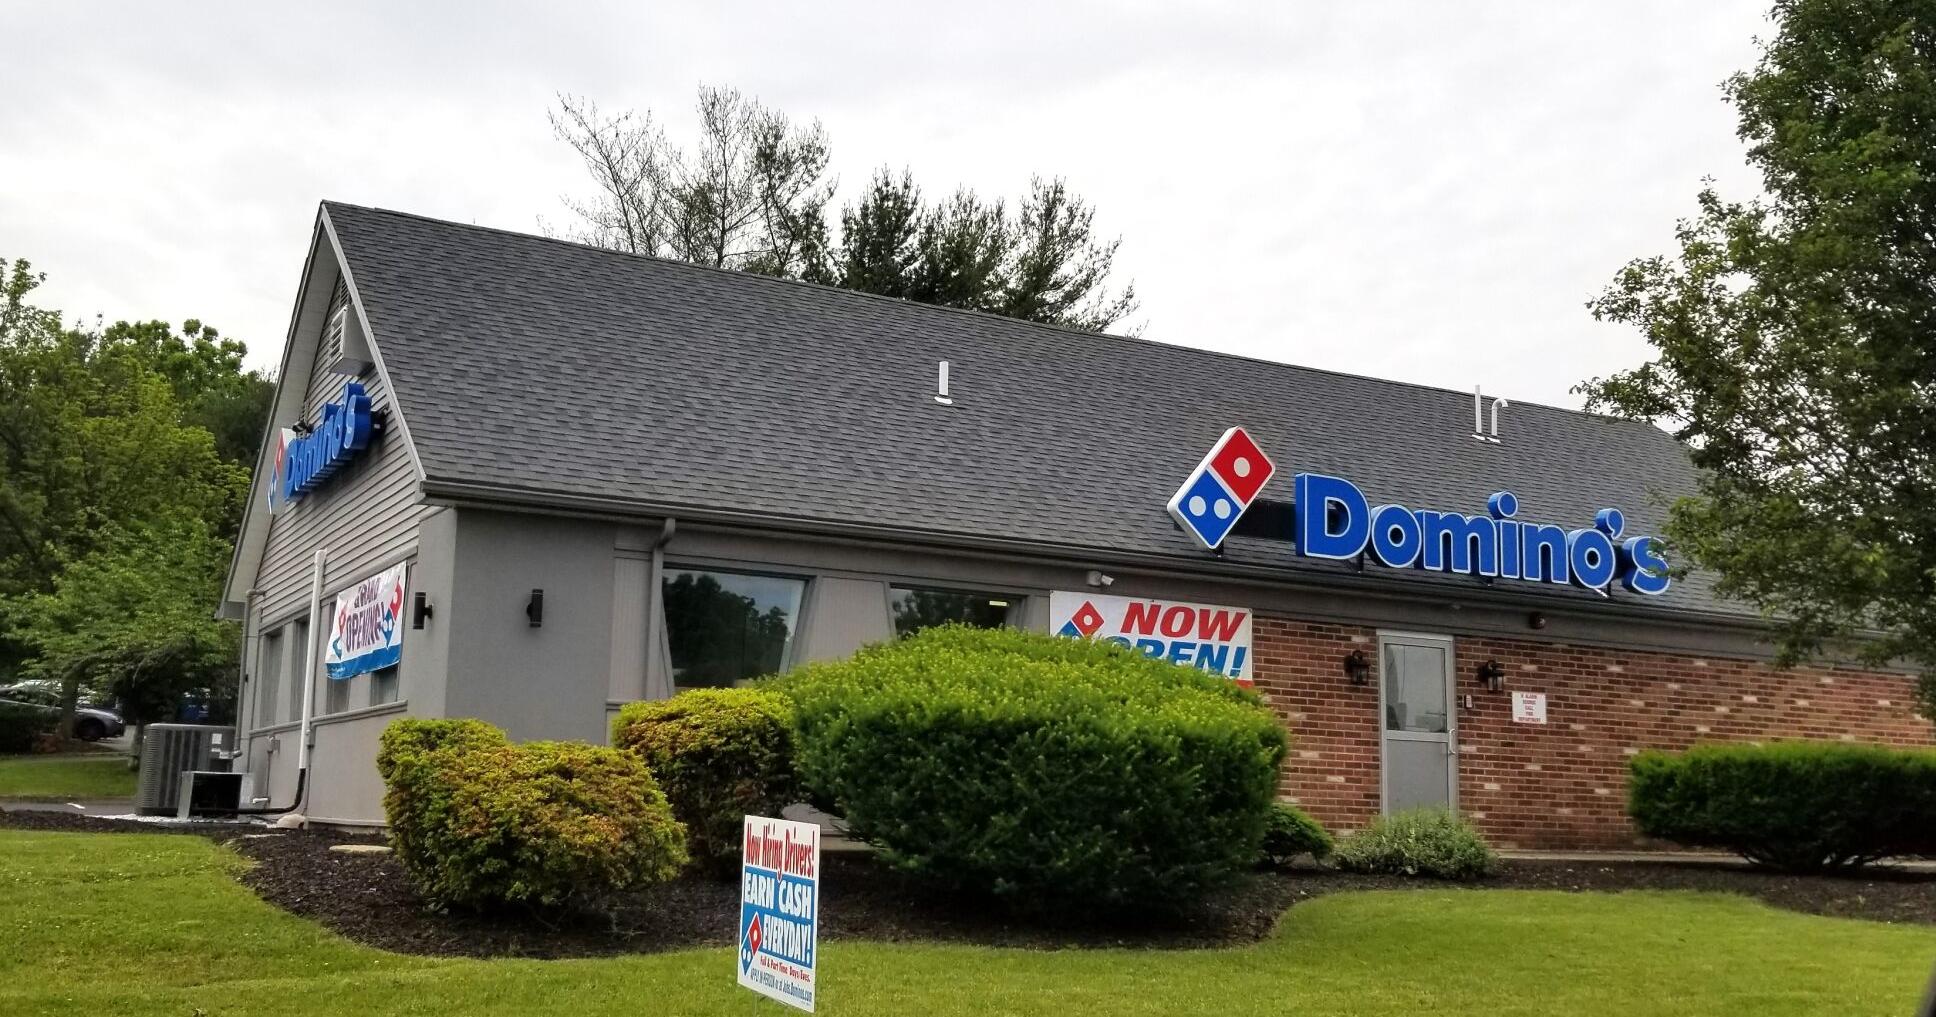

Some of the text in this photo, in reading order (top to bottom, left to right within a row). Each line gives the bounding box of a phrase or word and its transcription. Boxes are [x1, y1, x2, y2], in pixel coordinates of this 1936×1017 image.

[283, 382, 370, 502] Domino's
[1295, 472, 1671, 596] Domino's
[1119, 602, 1247, 642] NOW
[745, 822, 815, 882] Now Hiring Drivers!
[744, 872, 812, 920] EARN CASH
[762, 914, 812, 964] EVERYDAY!
